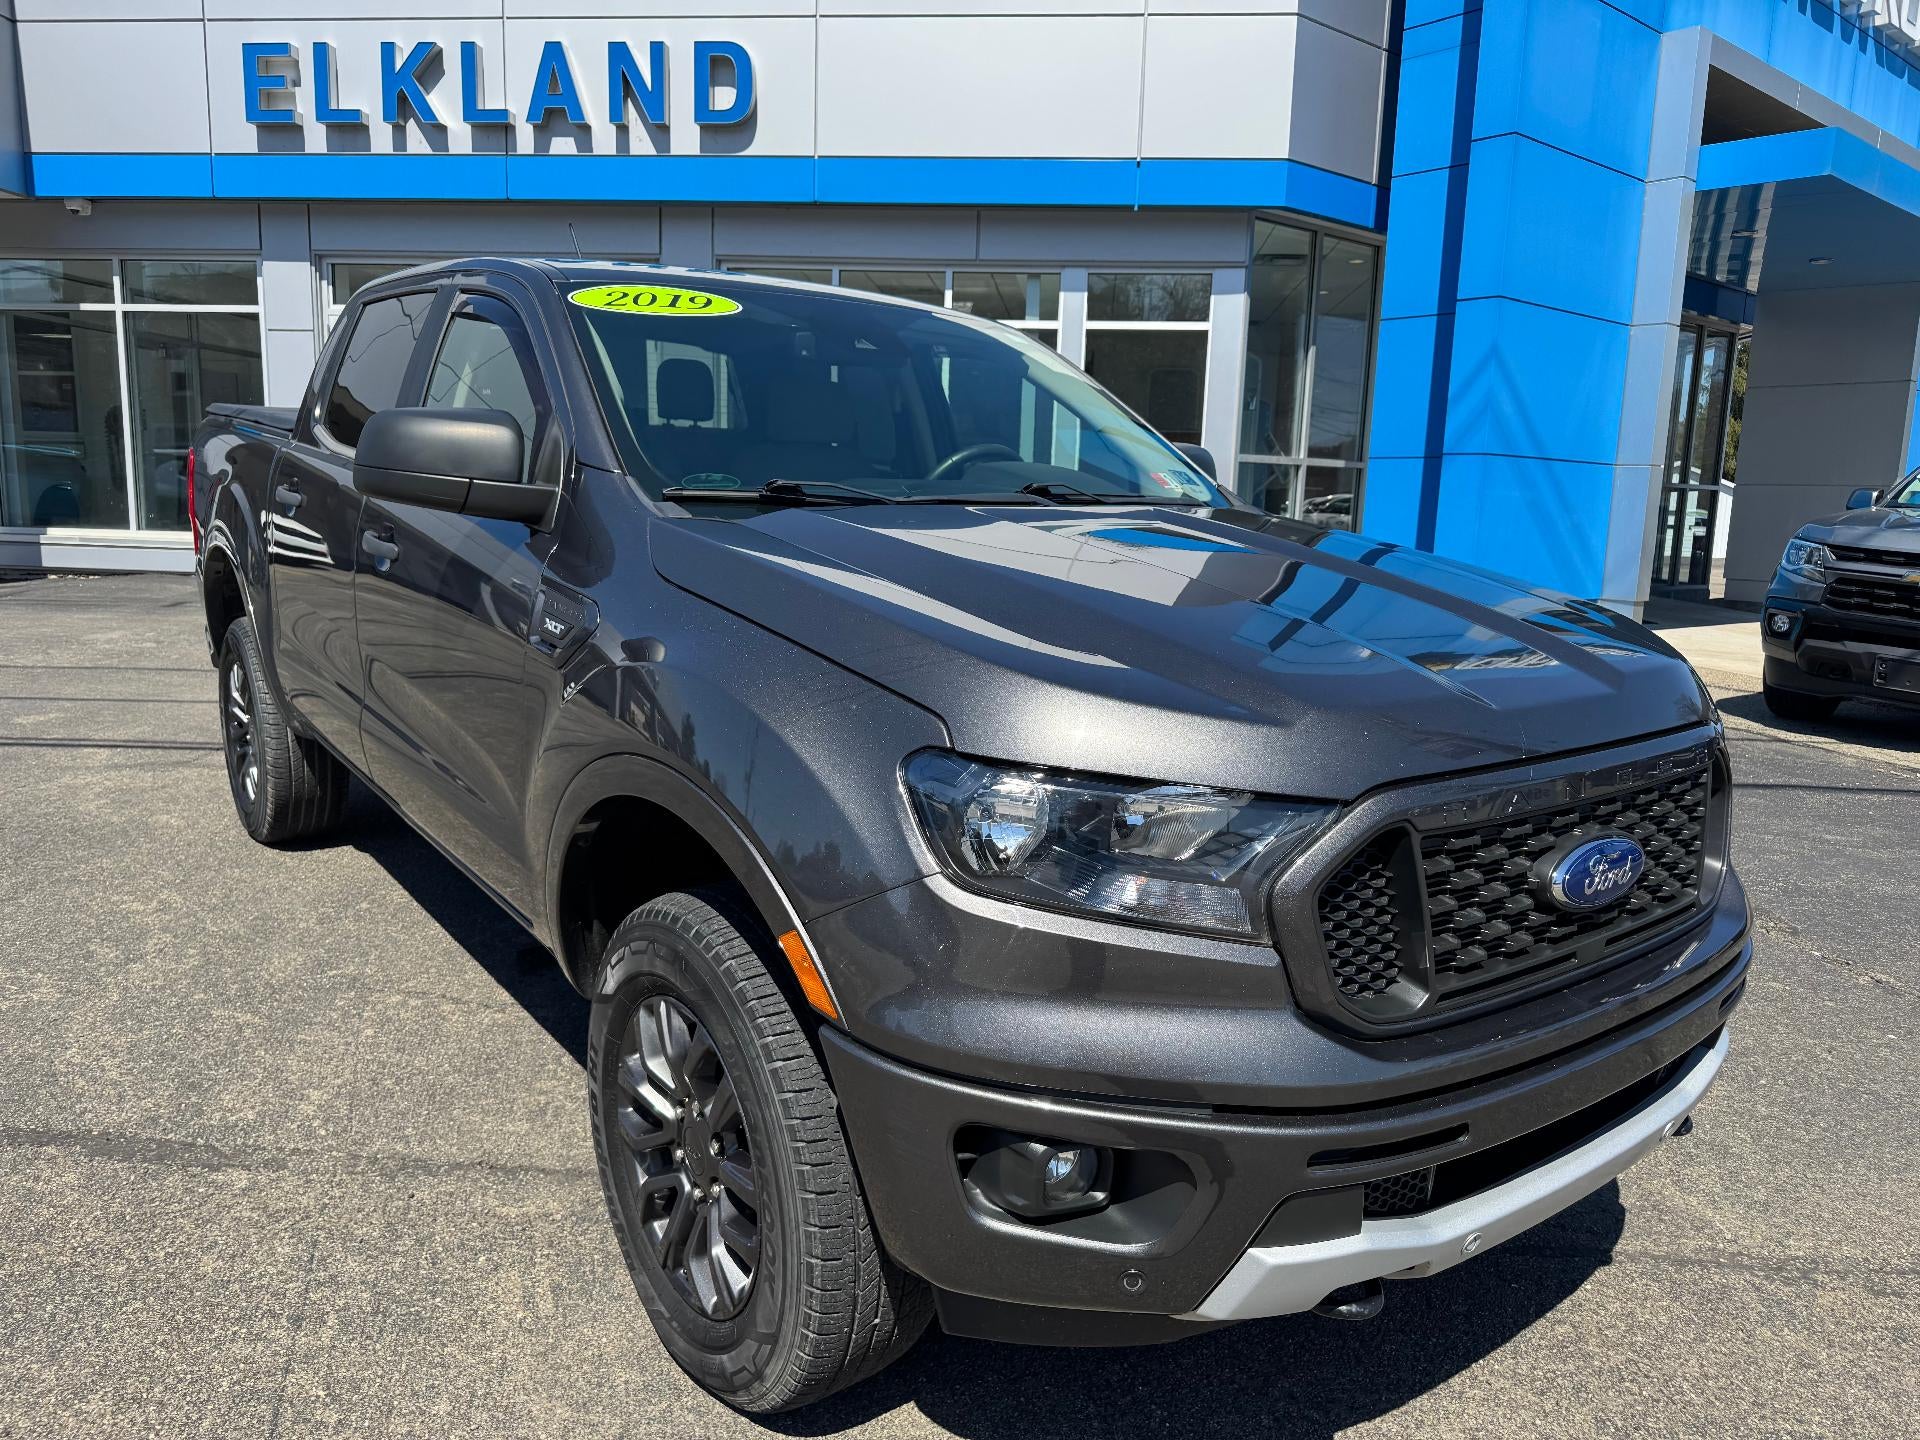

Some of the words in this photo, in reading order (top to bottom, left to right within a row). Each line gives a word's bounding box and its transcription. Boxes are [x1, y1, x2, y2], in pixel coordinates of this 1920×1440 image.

[242, 41, 757, 127] ELKLAND
[604, 291, 713, 309] 2019
[543, 617, 565, 635] XLT
[1584, 853, 1632, 895] Ford
